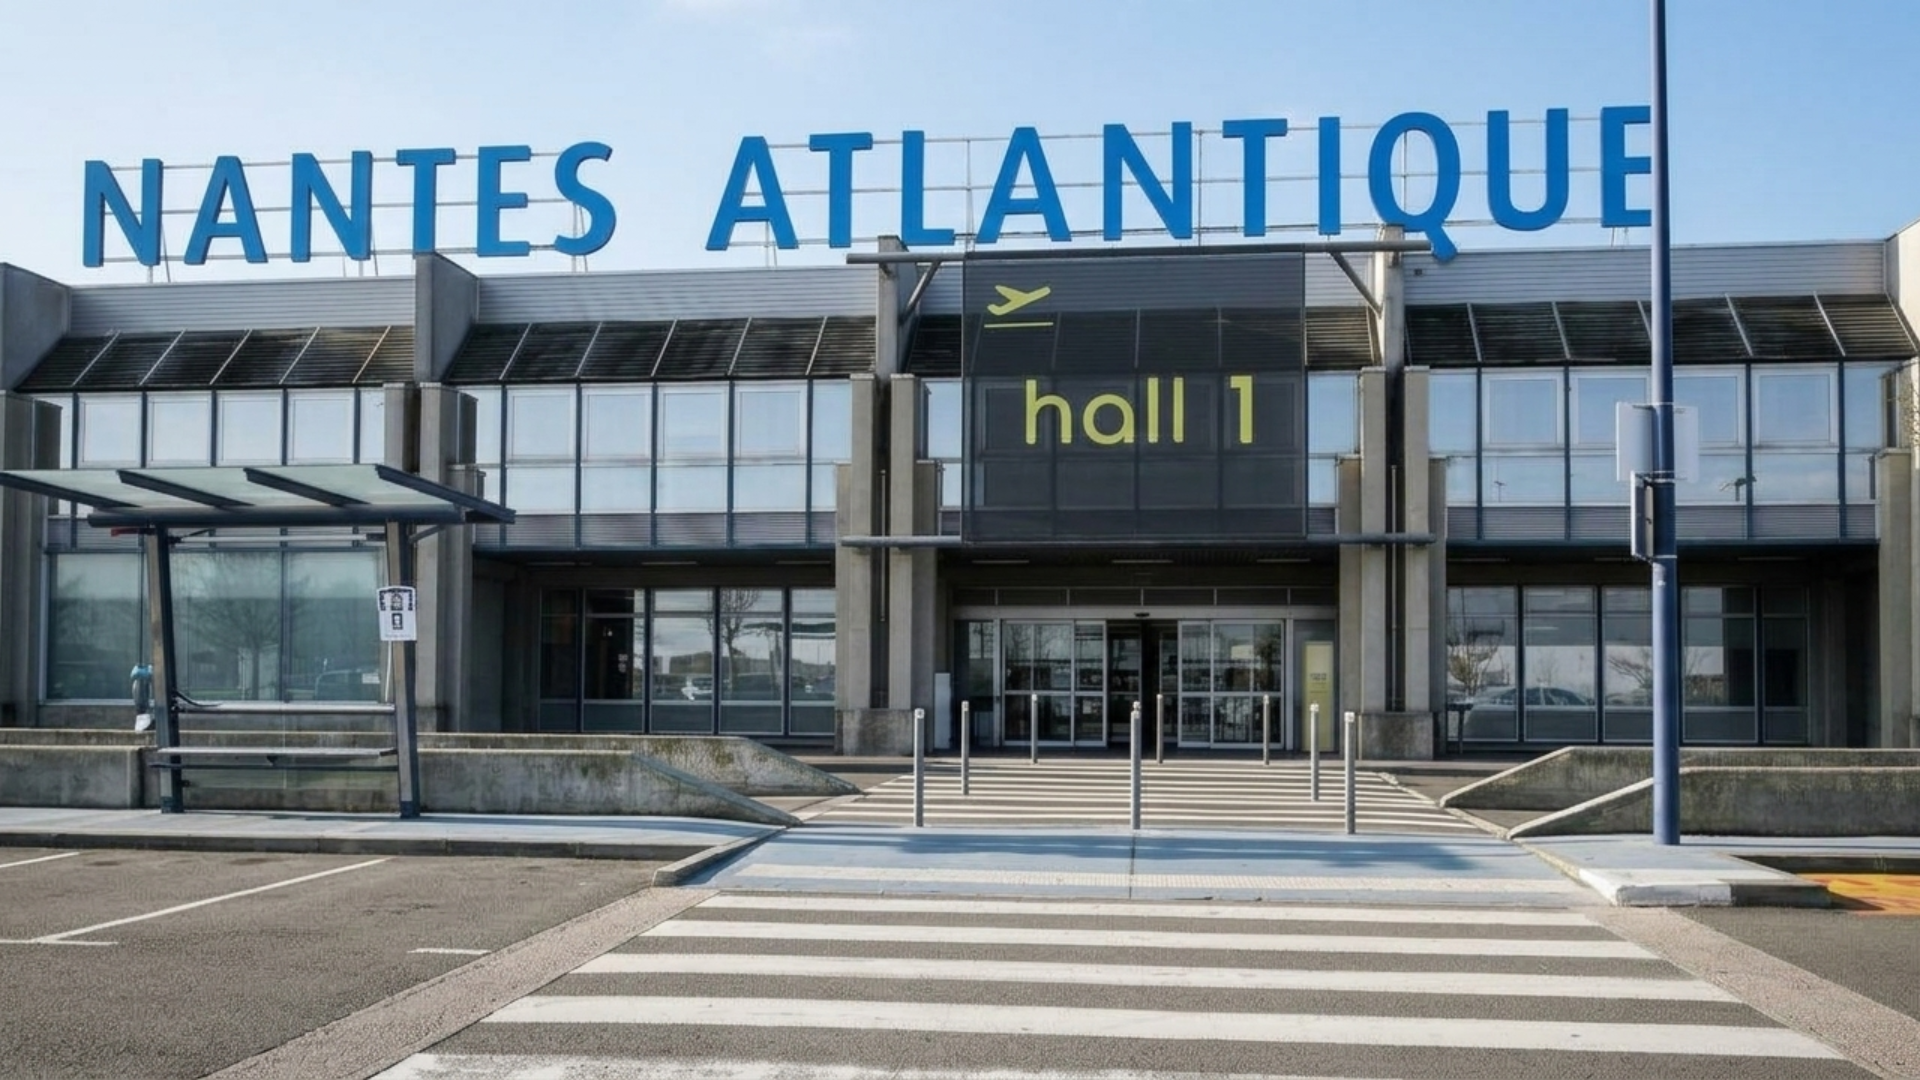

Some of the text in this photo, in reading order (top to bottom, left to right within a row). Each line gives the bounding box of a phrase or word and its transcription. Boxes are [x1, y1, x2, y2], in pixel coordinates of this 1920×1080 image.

[84, 106, 1652, 266] NANTES ATLANTIQUE
[1025, 375, 1254, 444] hall 1
